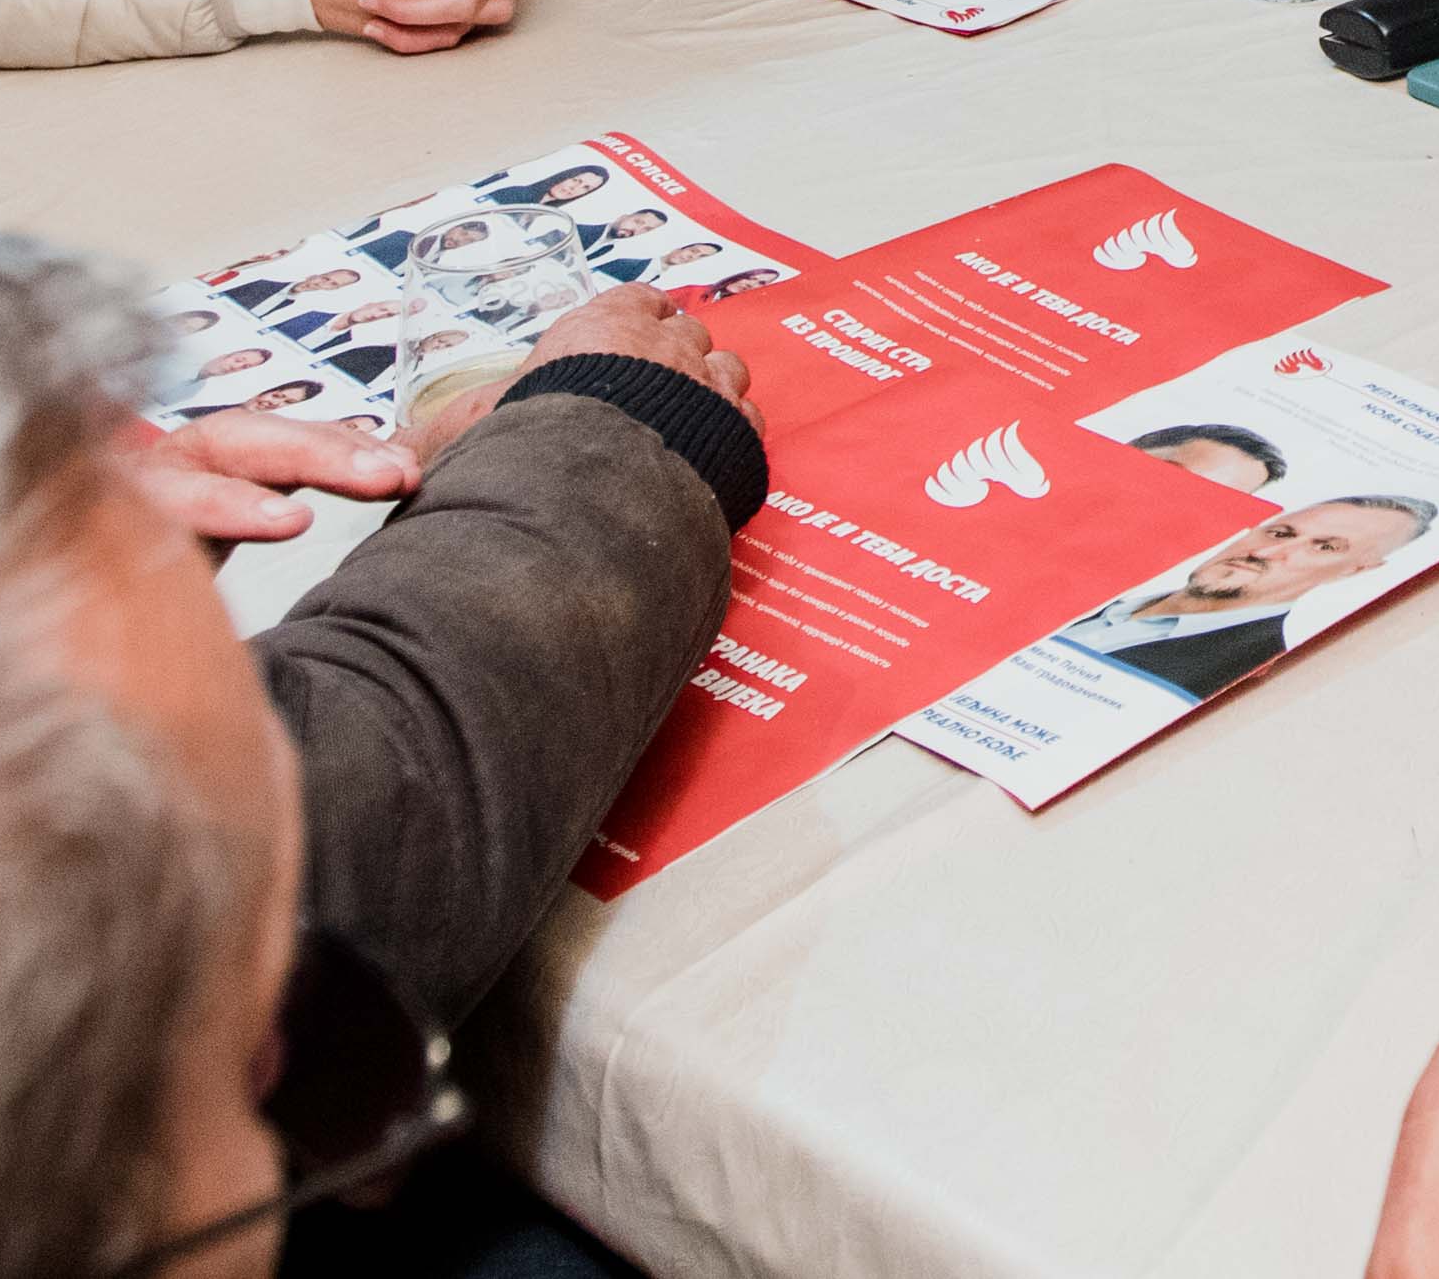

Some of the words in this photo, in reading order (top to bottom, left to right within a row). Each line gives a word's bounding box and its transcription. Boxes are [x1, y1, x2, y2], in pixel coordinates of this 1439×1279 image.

[954, 252, 1001, 275] АКО
[987, 271, 1022, 287] ЈЕ
[1011, 281, 1037, 294] И
[1029, 288, 1083, 317] ТЕБИ
[1068, 311, 1141, 346] ДОСТА
[780, 313, 817, 335] ИЗ
[804, 330, 904, 381] ПРОШЛОГ
[823, 309, 898, 353] СТАРИХ
[799, 511, 840, 530] ЈЕ
[828, 520, 859, 537] И
[850, 530, 917, 567] ТЕБИ
[900, 559, 991, 604] ДОСТА
[710, 633, 808, 693] РАНАКА
[690, 668, 785, 721] ВИЈЕКА
[920, 708, 981, 740] РЕАЛНО
[976, 735, 1028, 762] БОЉЕ
[1011, 718, 1062, 746] МОЖЕ
